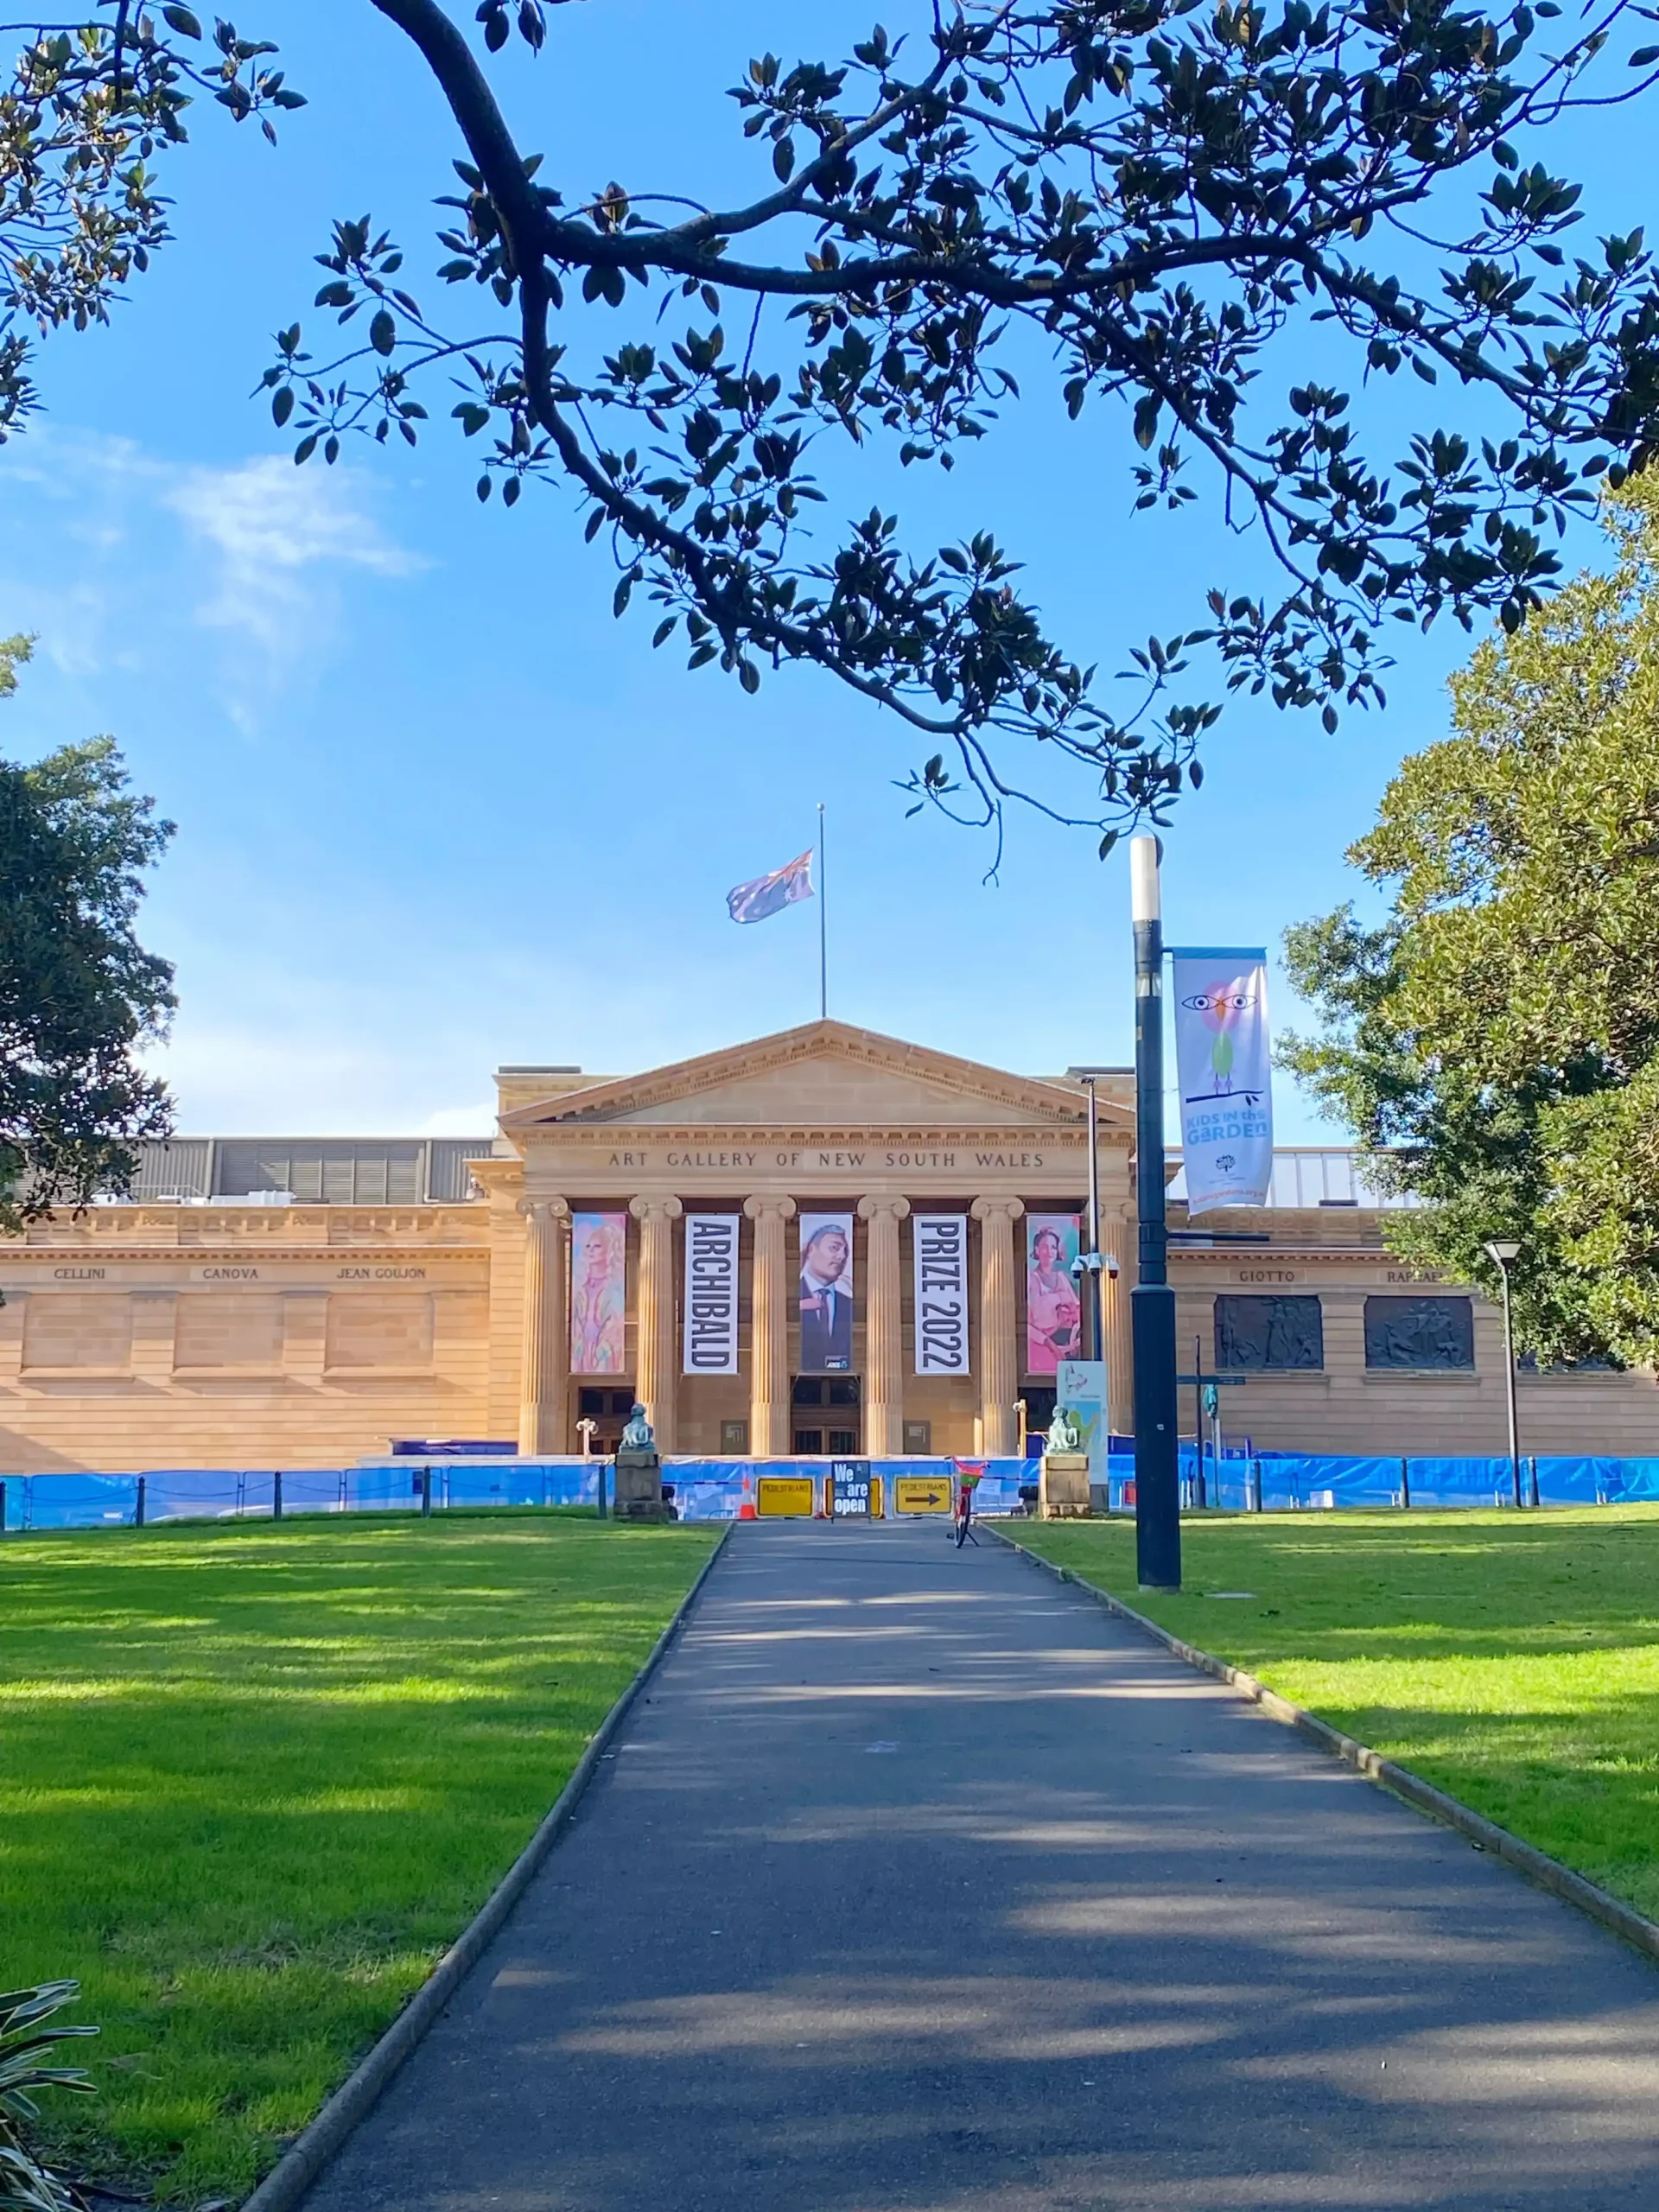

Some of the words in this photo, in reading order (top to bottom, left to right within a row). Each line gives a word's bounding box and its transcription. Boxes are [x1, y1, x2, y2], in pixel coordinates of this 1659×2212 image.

[608, 1153, 648, 1166] ART
[666, 1153, 757, 1166] GALLERY
[776, 1153, 800, 1166] OF
[819, 1153, 865, 1166] NEW
[885, 1153, 955, 1166] SOUTH
[976, 1153, 1044, 1166] WALES
[921, 1222, 961, 1293] PRIZE
[54, 1268, 105, 1279] CELLINI
[203, 1268, 259, 1279] CANOVA
[336, 1268, 370, 1279] JEAN
[375, 1268, 426, 1279] GOUJON
[1239, 1271, 1295, 1282] GIOTTO
[691, 1222, 732, 1367] ARCHIBALD
[922, 1302, 963, 1368] 2022
[834, 1463, 855, 1482] We
[847, 1483, 868, 1497] are
[834, 1498, 867, 1516] open
